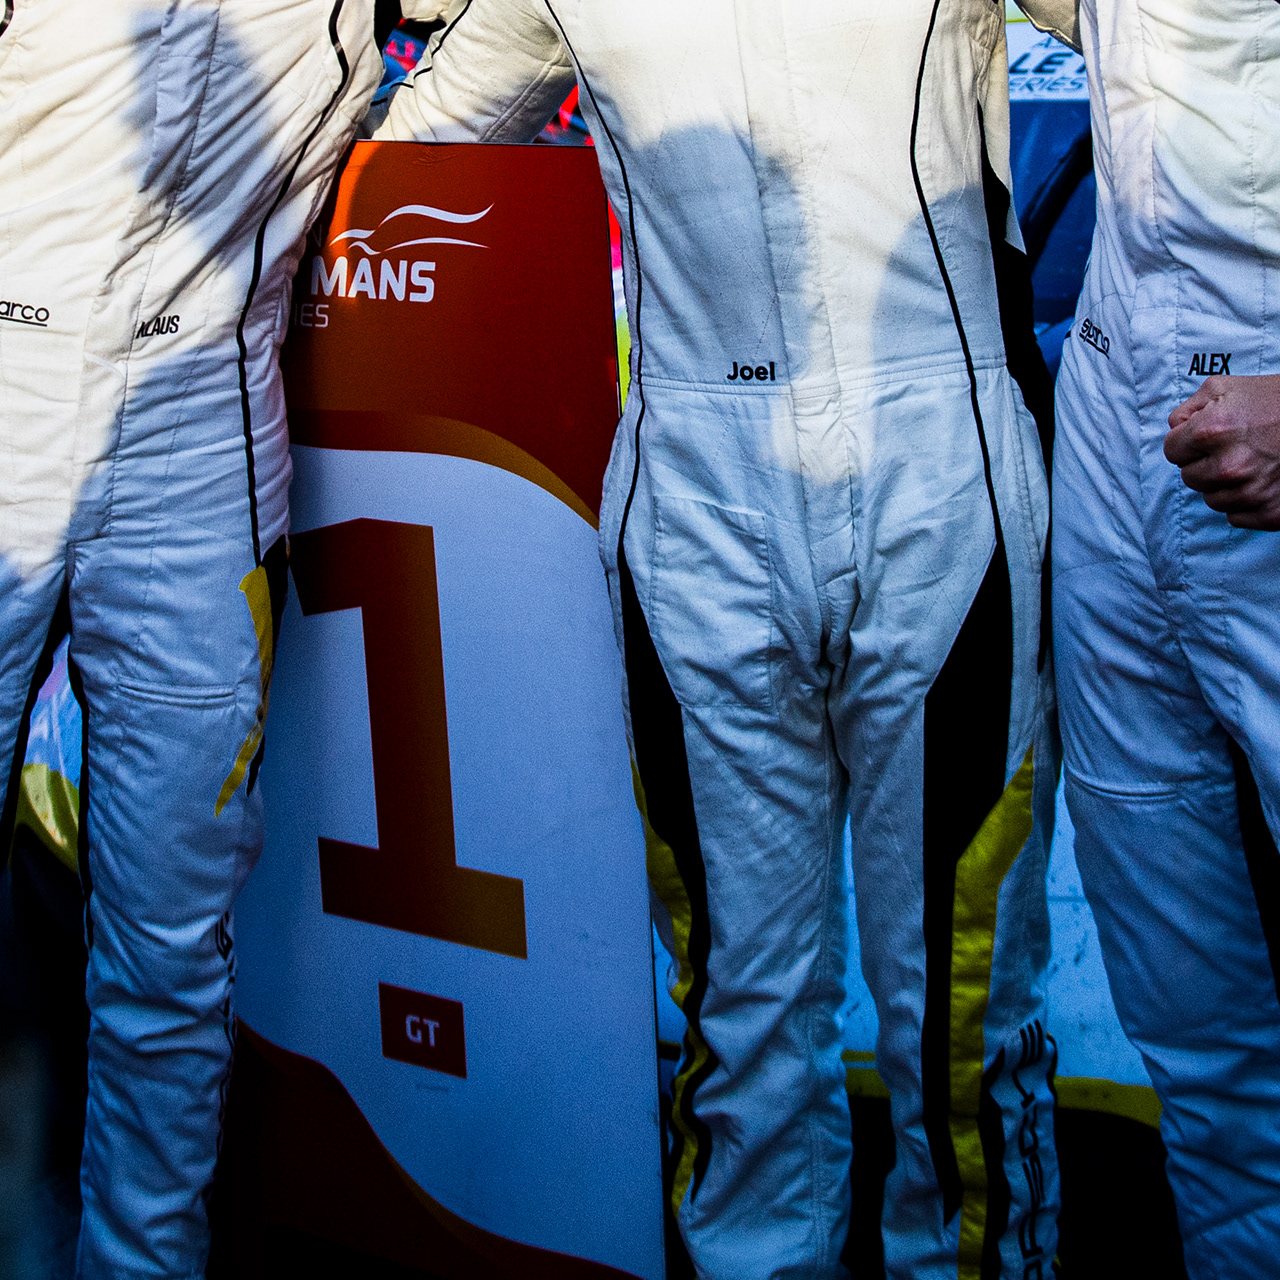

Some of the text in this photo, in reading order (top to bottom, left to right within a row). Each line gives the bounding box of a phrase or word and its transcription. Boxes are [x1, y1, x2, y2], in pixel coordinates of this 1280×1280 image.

[1008, 77, 1086, 93] ERIES
[310, 255, 437, 303] MANS
[135, 315, 180, 339] KLAUS
[727, 361, 776, 382] Joel
[1188, 353, 1232, 376] ALEX
[288, 517, 529, 960] 1
[404, 1013, 441, 1048] GT
